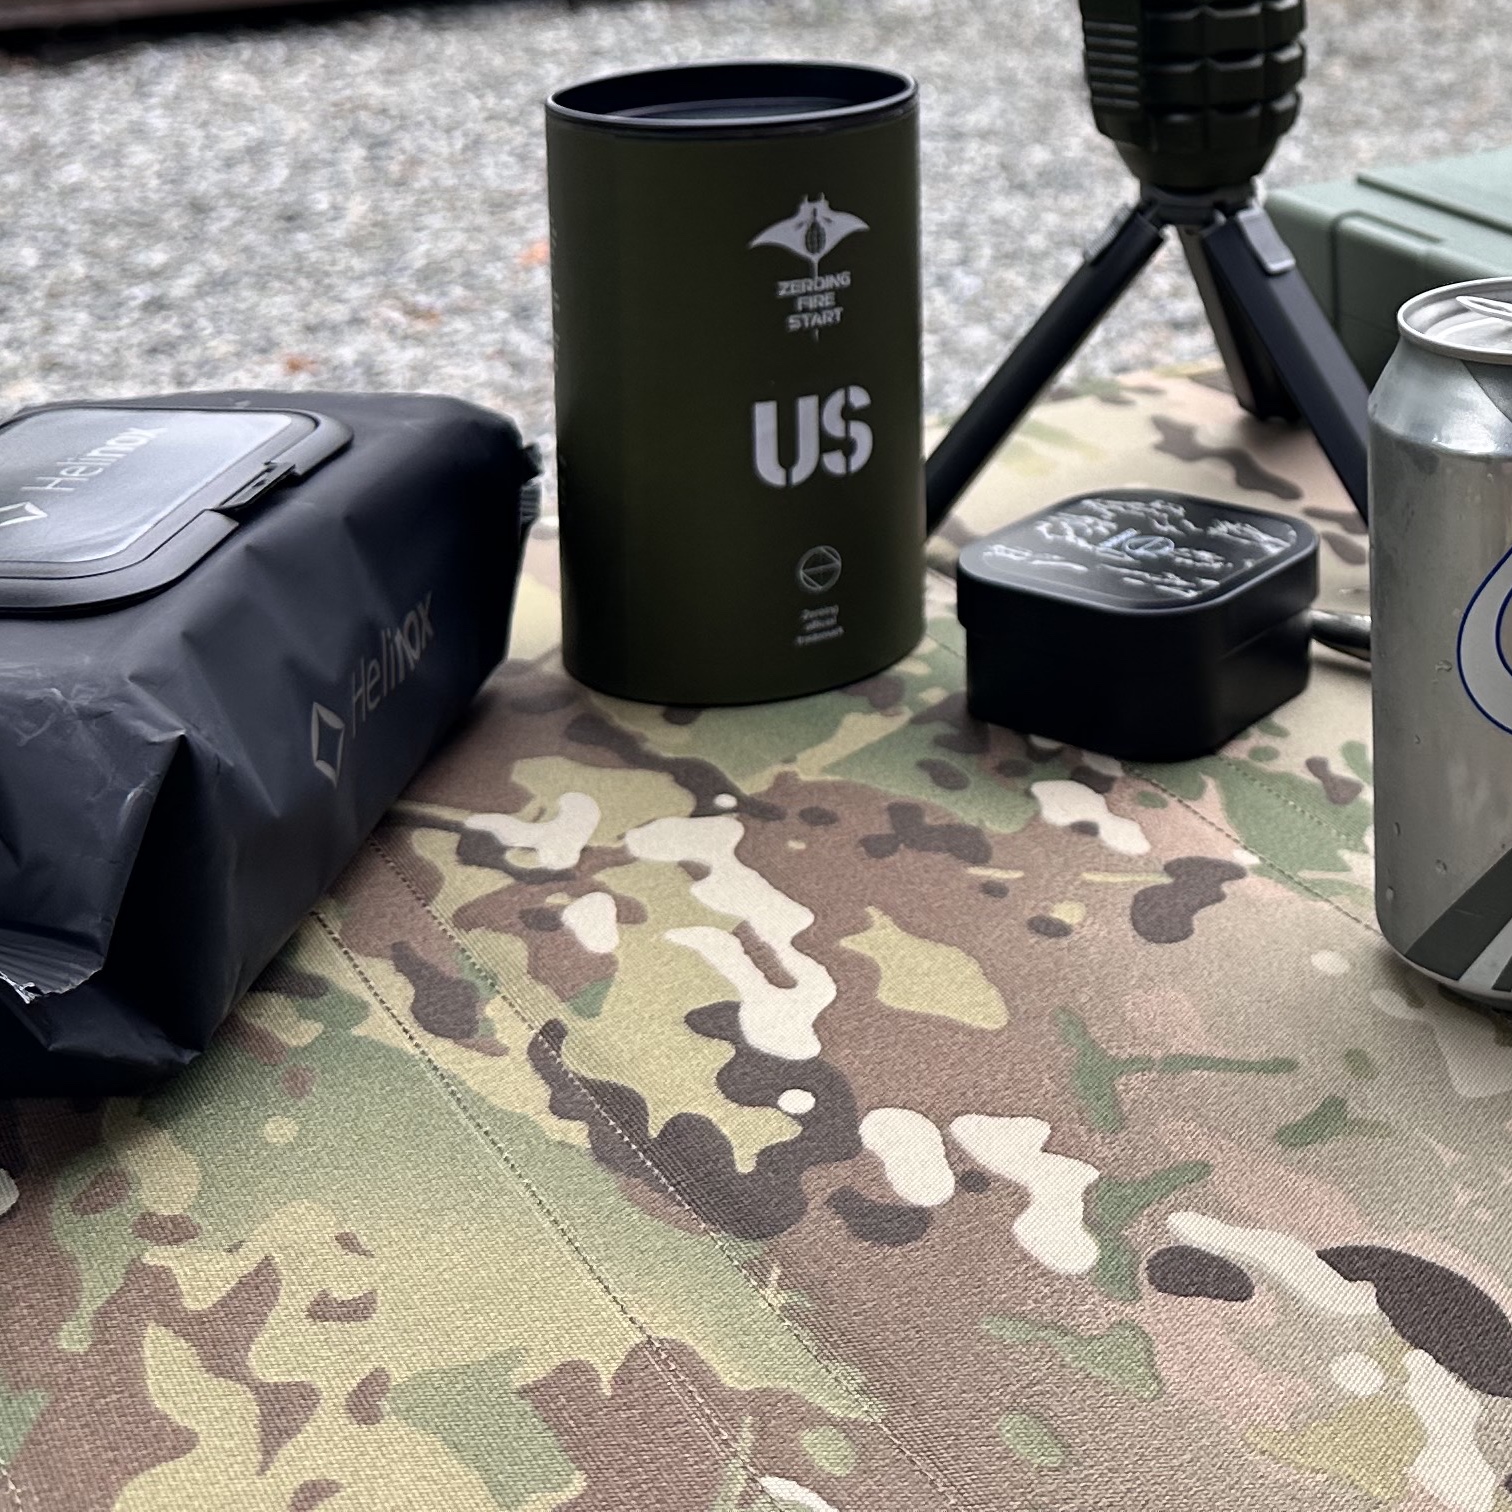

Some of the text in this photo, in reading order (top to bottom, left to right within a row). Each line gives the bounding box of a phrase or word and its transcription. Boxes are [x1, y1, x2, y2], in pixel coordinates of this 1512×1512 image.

[775, 269, 852, 298] ZEROING
[796, 290, 837, 312] FIRE
[785, 305, 844, 332] START
[20, 426, 169, 492] Helinox
[753, 384, 875, 488] US
[352, 589, 435, 739] Helinox
